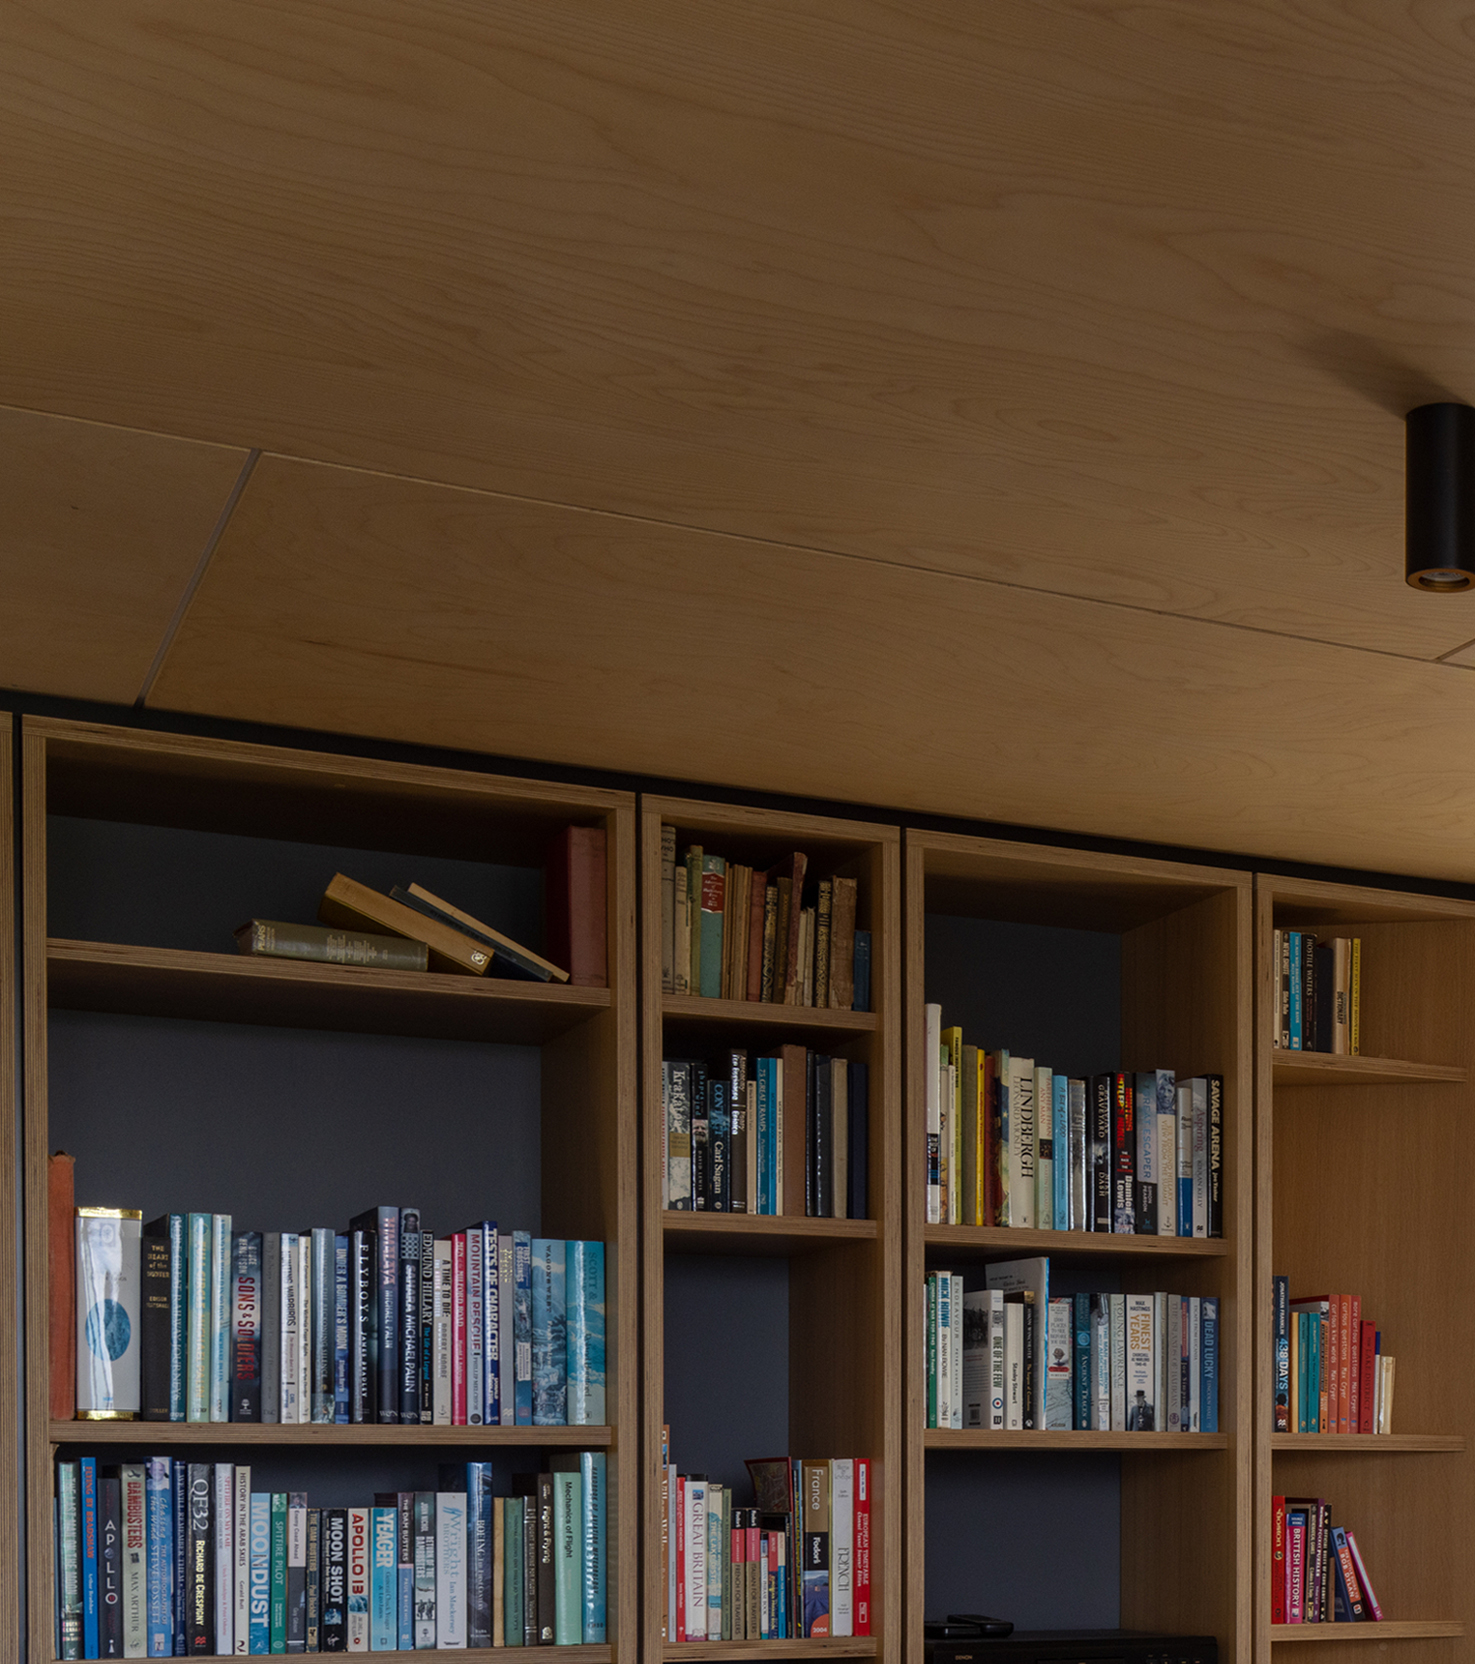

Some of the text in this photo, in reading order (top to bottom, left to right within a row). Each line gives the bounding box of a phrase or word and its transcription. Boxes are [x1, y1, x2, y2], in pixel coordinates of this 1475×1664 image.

[759, 1068, 767, 1132] 75 GREAT TRAMPS
[1020, 1078, 1033, 1178] LINDBERGH
[1211, 1080, 1220, 1170] SAVAGE ARENA
[714, 1141, 724, 1193] Carl Sagan
[1117, 1180, 1125, 1208] Lewis
[1124, 1176, 1133, 1214] Damien
[238, 1277, 255, 1310] SONS
[360, 1244, 369, 1322] FLYBOYS
[423, 1233, 433, 1325] EDMUND HILLARY
[471, 1234, 481, 1350] MOUNTAIN RESCUE
[486, 1228, 497, 1360] TESTS OF CHARACTER
[237, 1320, 255, 1380] SOLDIERS
[405, 1264, 416, 1392] SAHARA MICHAEL PALIN
[993, 1336, 1002, 1349] ONE
[1130, 1315, 1139, 1350] YEARS
[1141, 1314, 1150, 1351] FINEST
[1204, 1322, 1214, 1378] DEAD LUCKY
[993, 1360, 1002, 1372] THE
[993, 1374, 1002, 1388] FEW
[1279, 1360, 1288, 1390] DAYS
[86, 1467, 95, 1558] FLYING BY BRADSHAW
[127, 1482, 142, 1548] DAMBUSTERS
[191, 1479, 209, 1530] QF32
[565, 1481, 573, 1524] Mechanics
[812, 1469, 824, 1510] France
[251, 1502, 269, 1627] MOONDUST
[275, 1521, 283, 1585] SPITFIRE PILOT
[331, 1517, 343, 1603] MOON SHOT
[352, 1514, 364, 1594] APOLLO 13
[376, 1513, 394, 1567] YEAGER
[565, 1535, 573, 1558] Flight
[693, 1502, 704, 1607] GREAT BRITAIN
[1292, 1528, 1301, 1606] BRITISH HISTORY
